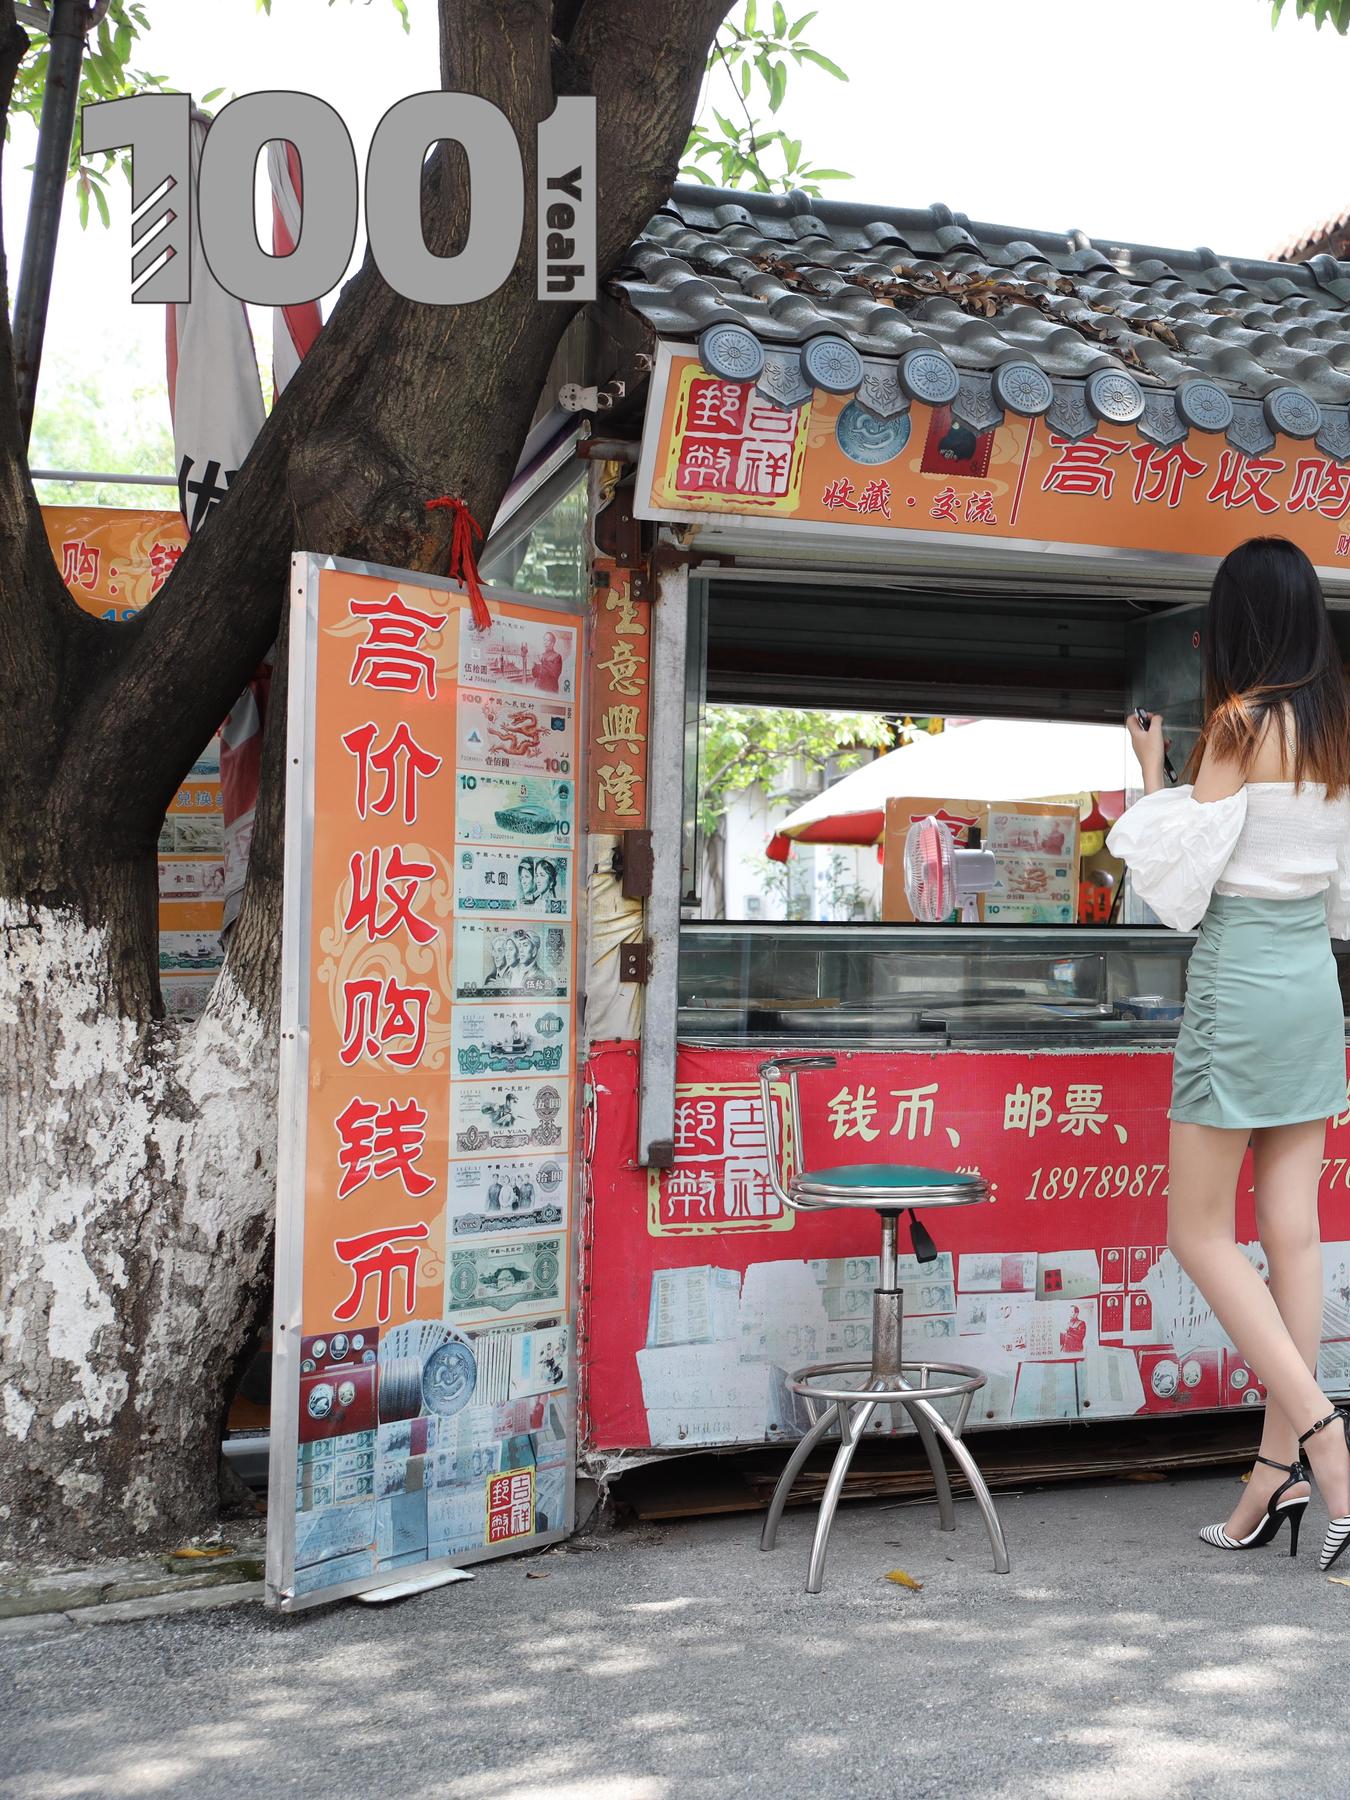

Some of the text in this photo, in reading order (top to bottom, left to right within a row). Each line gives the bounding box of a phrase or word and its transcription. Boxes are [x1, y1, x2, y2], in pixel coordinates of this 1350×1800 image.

[544, 758, 570, 773] 100
[460, 774, 477, 790] 10
[554, 820, 571, 836] 10
[332, 593, 448, 1322] 高价收购钱币
